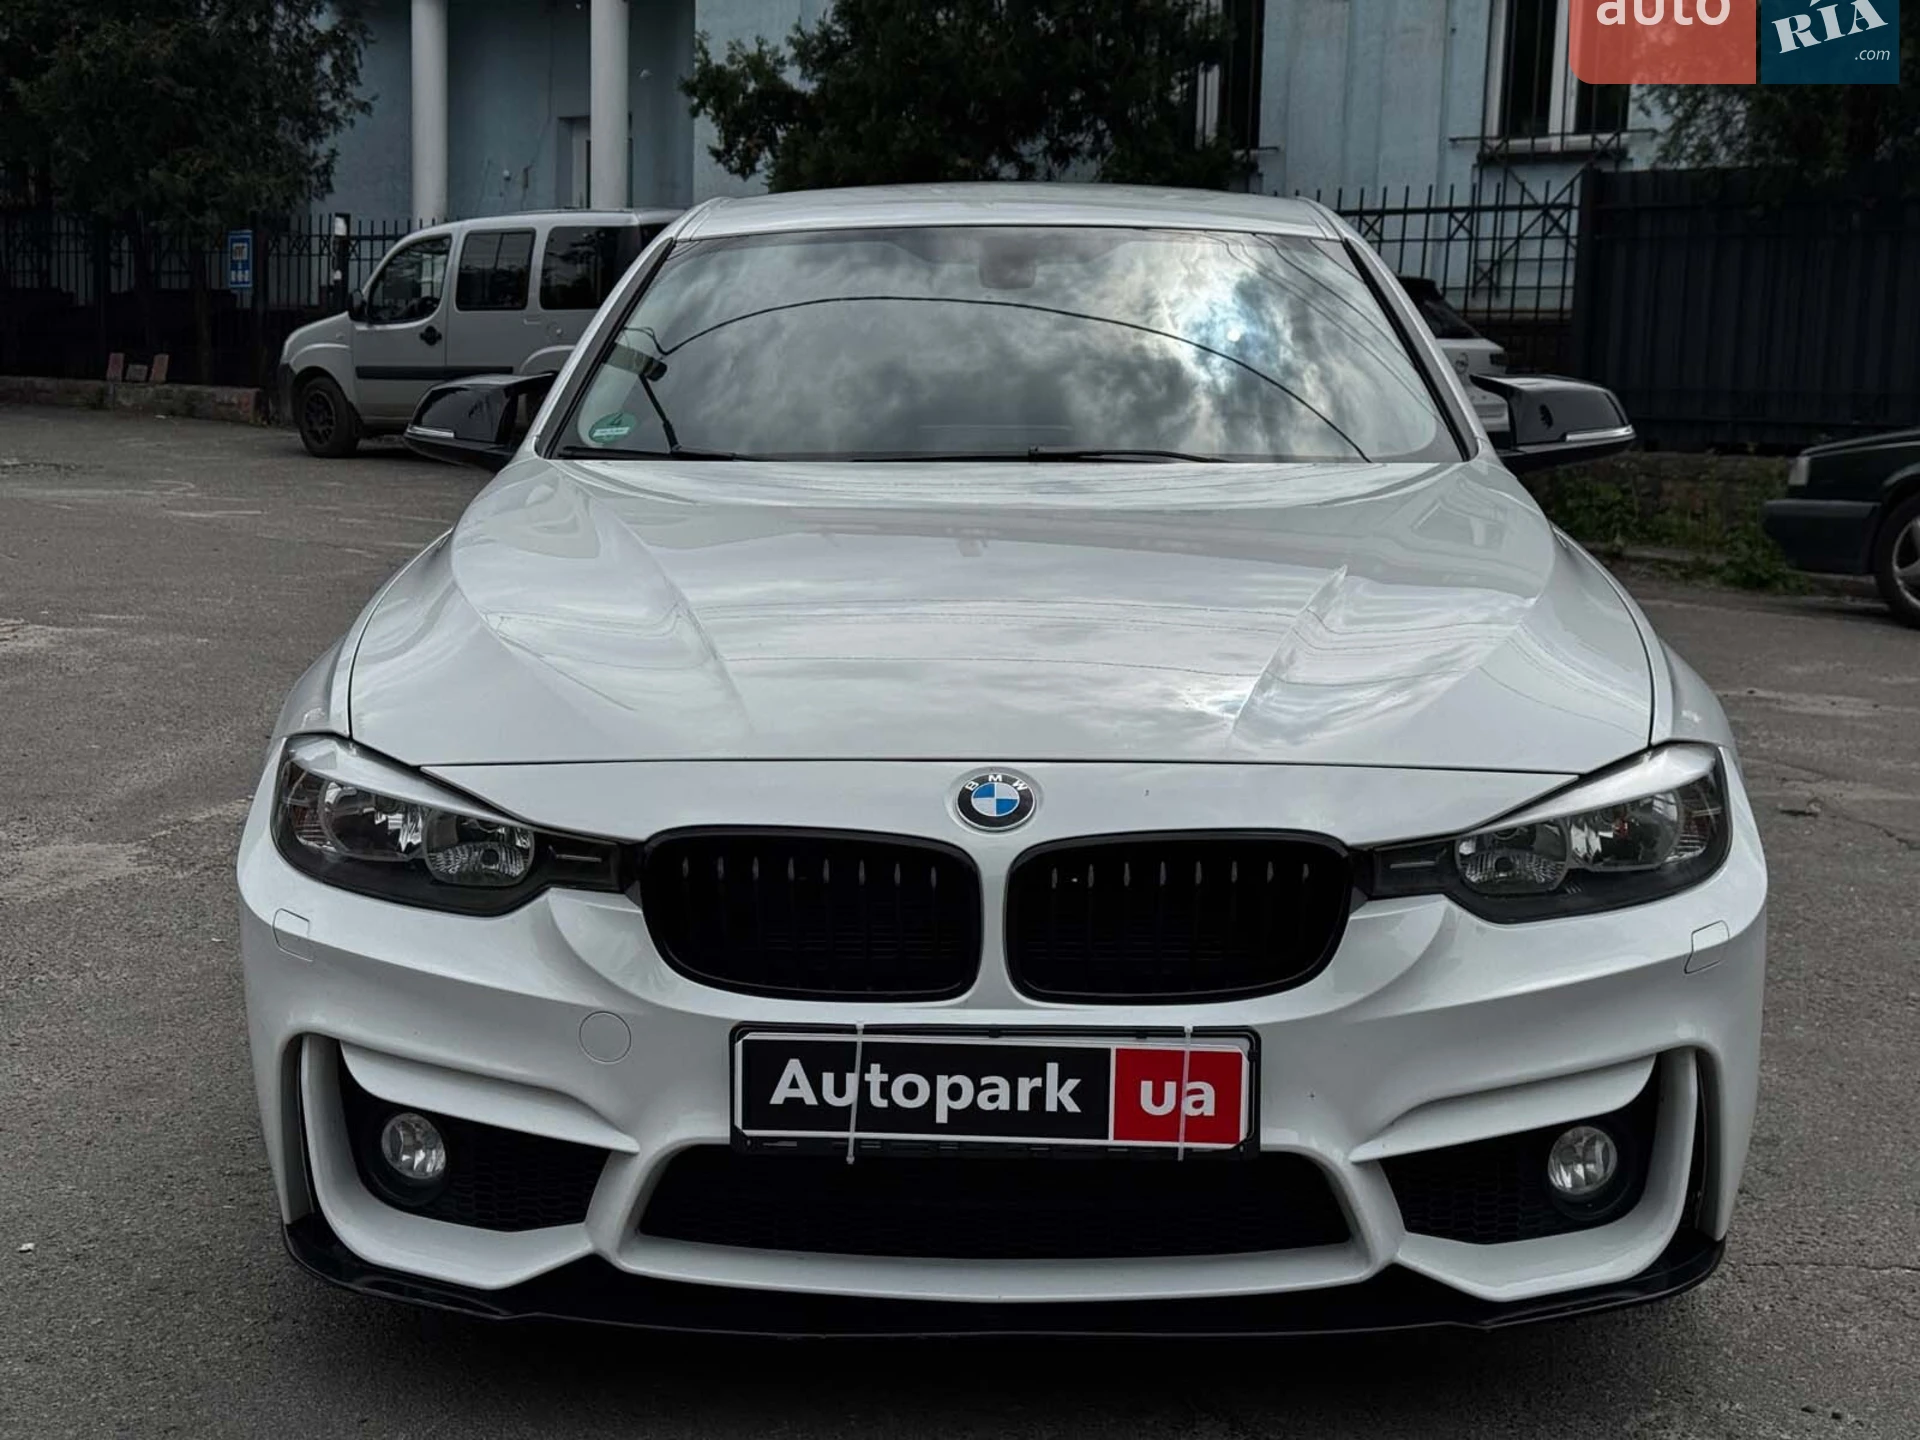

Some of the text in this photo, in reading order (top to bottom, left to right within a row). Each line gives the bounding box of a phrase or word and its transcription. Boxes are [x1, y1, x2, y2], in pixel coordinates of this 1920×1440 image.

[964, 774, 1028, 791] BMW
[769, 1058, 1216, 1124] Autopark ua
